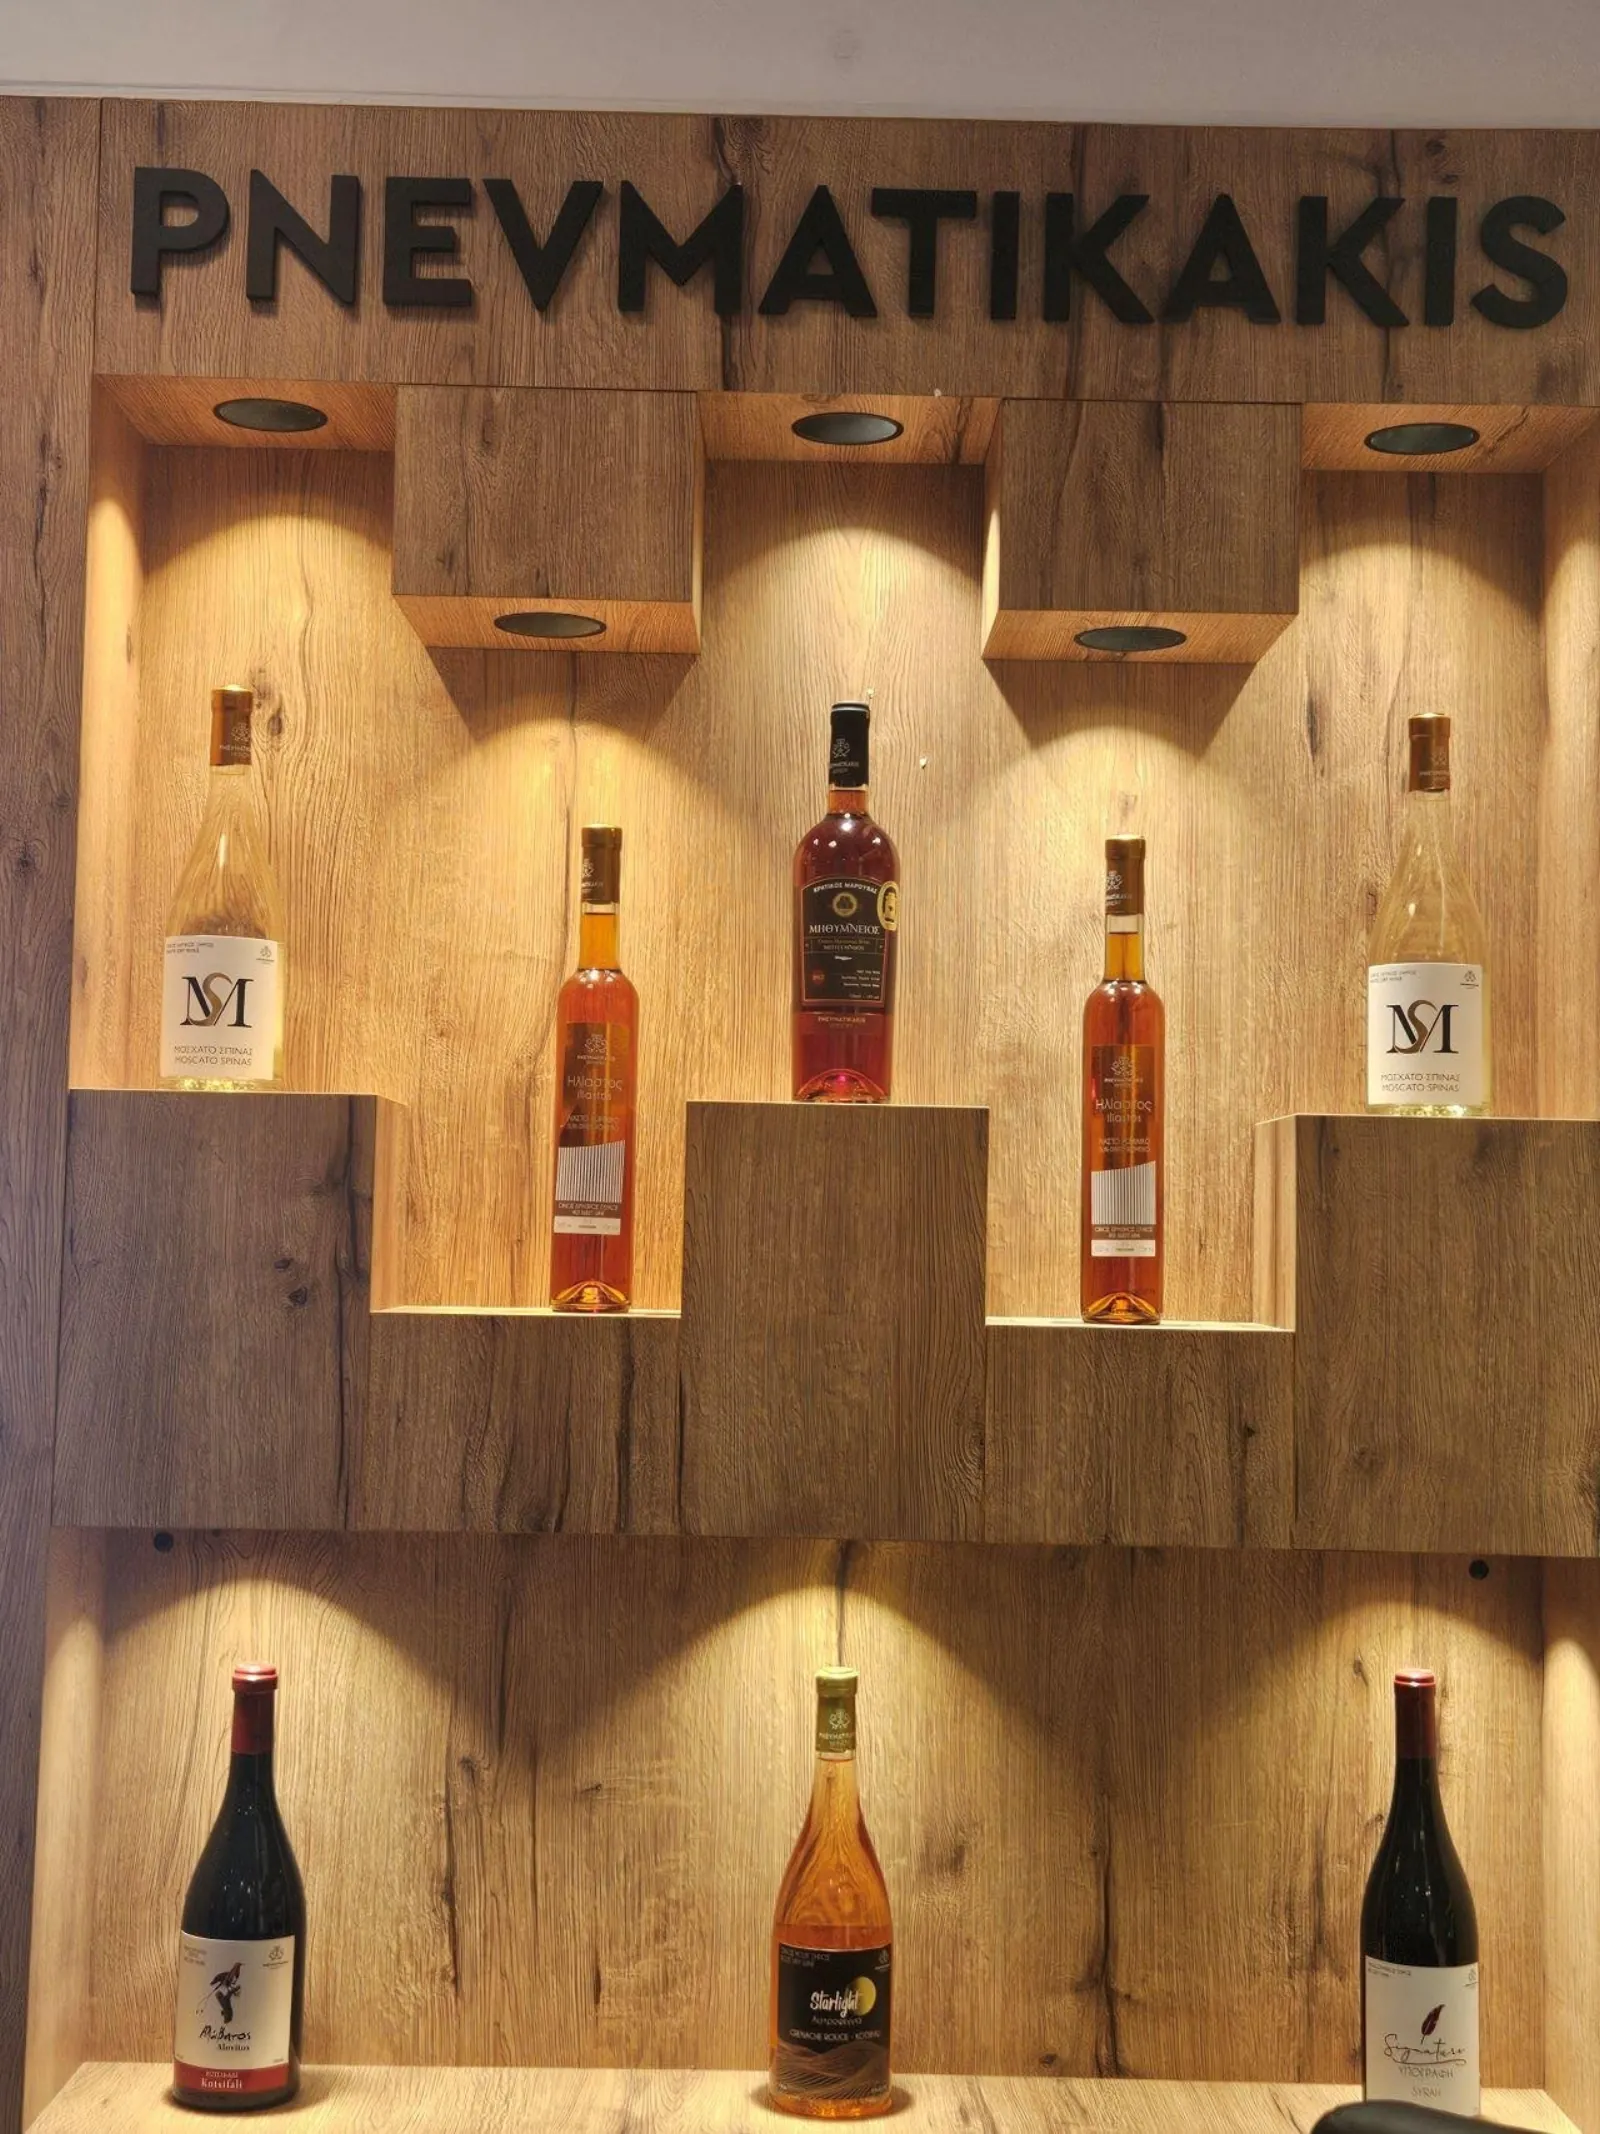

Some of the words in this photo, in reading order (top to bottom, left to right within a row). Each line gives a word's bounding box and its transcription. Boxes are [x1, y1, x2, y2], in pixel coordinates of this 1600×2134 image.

[131, 166, 1569, 330] PNEVMATIKAKIS
[174, 1046, 217, 1055] ΜΟΣΧΑΤΟ
[219, 1047, 253, 1056] ΣΠΙΝΑΣ
[175, 1056, 218, 1065] MOSCATO
[220, 1057, 252, 1066] SPINAS
[1382, 1083, 1425, 1092] MOSCATO
[1426, 1083, 1460, 1093] SPINAS
[810, 1989, 862, 2018] Starlight
[201, 2078, 242, 2089] Kotsifali
